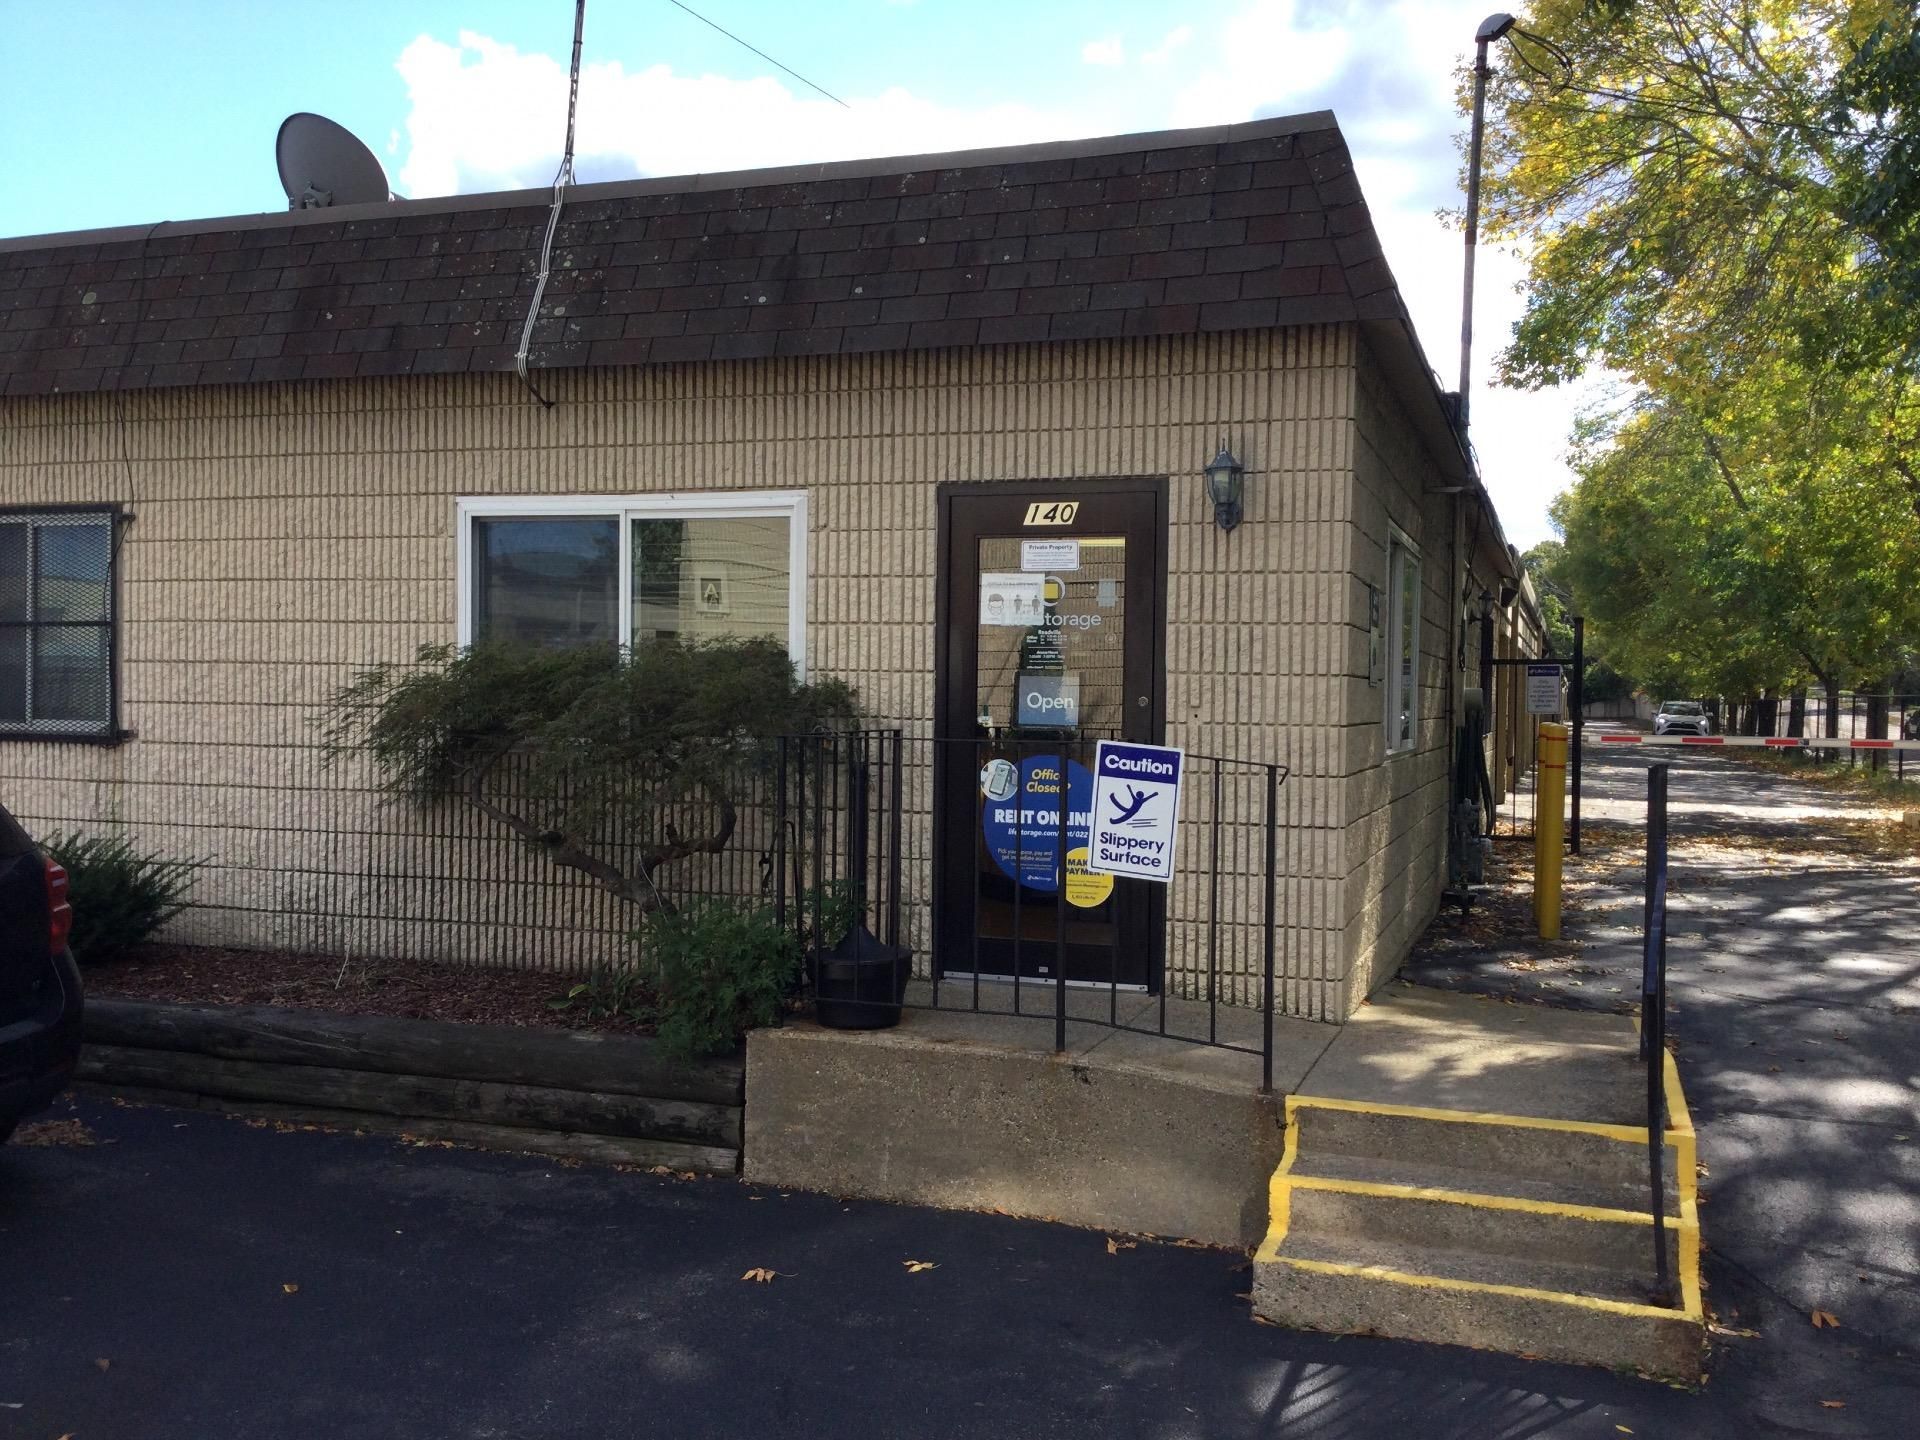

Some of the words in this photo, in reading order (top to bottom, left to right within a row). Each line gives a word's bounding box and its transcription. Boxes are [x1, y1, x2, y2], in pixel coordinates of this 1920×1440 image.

[1031, 504, 1074, 523] 140
[1044, 613, 1102, 629] torage
[1027, 692, 1074, 712] Open
[1031, 768, 1061, 781] Offic
[1105, 755, 1173, 775] Caution
[1036, 811, 1091, 826] ONIN
[1100, 832, 1165, 853] Slippery
[1067, 859, 1088, 867] MAK
[1100, 848, 1161, 867] Surface
